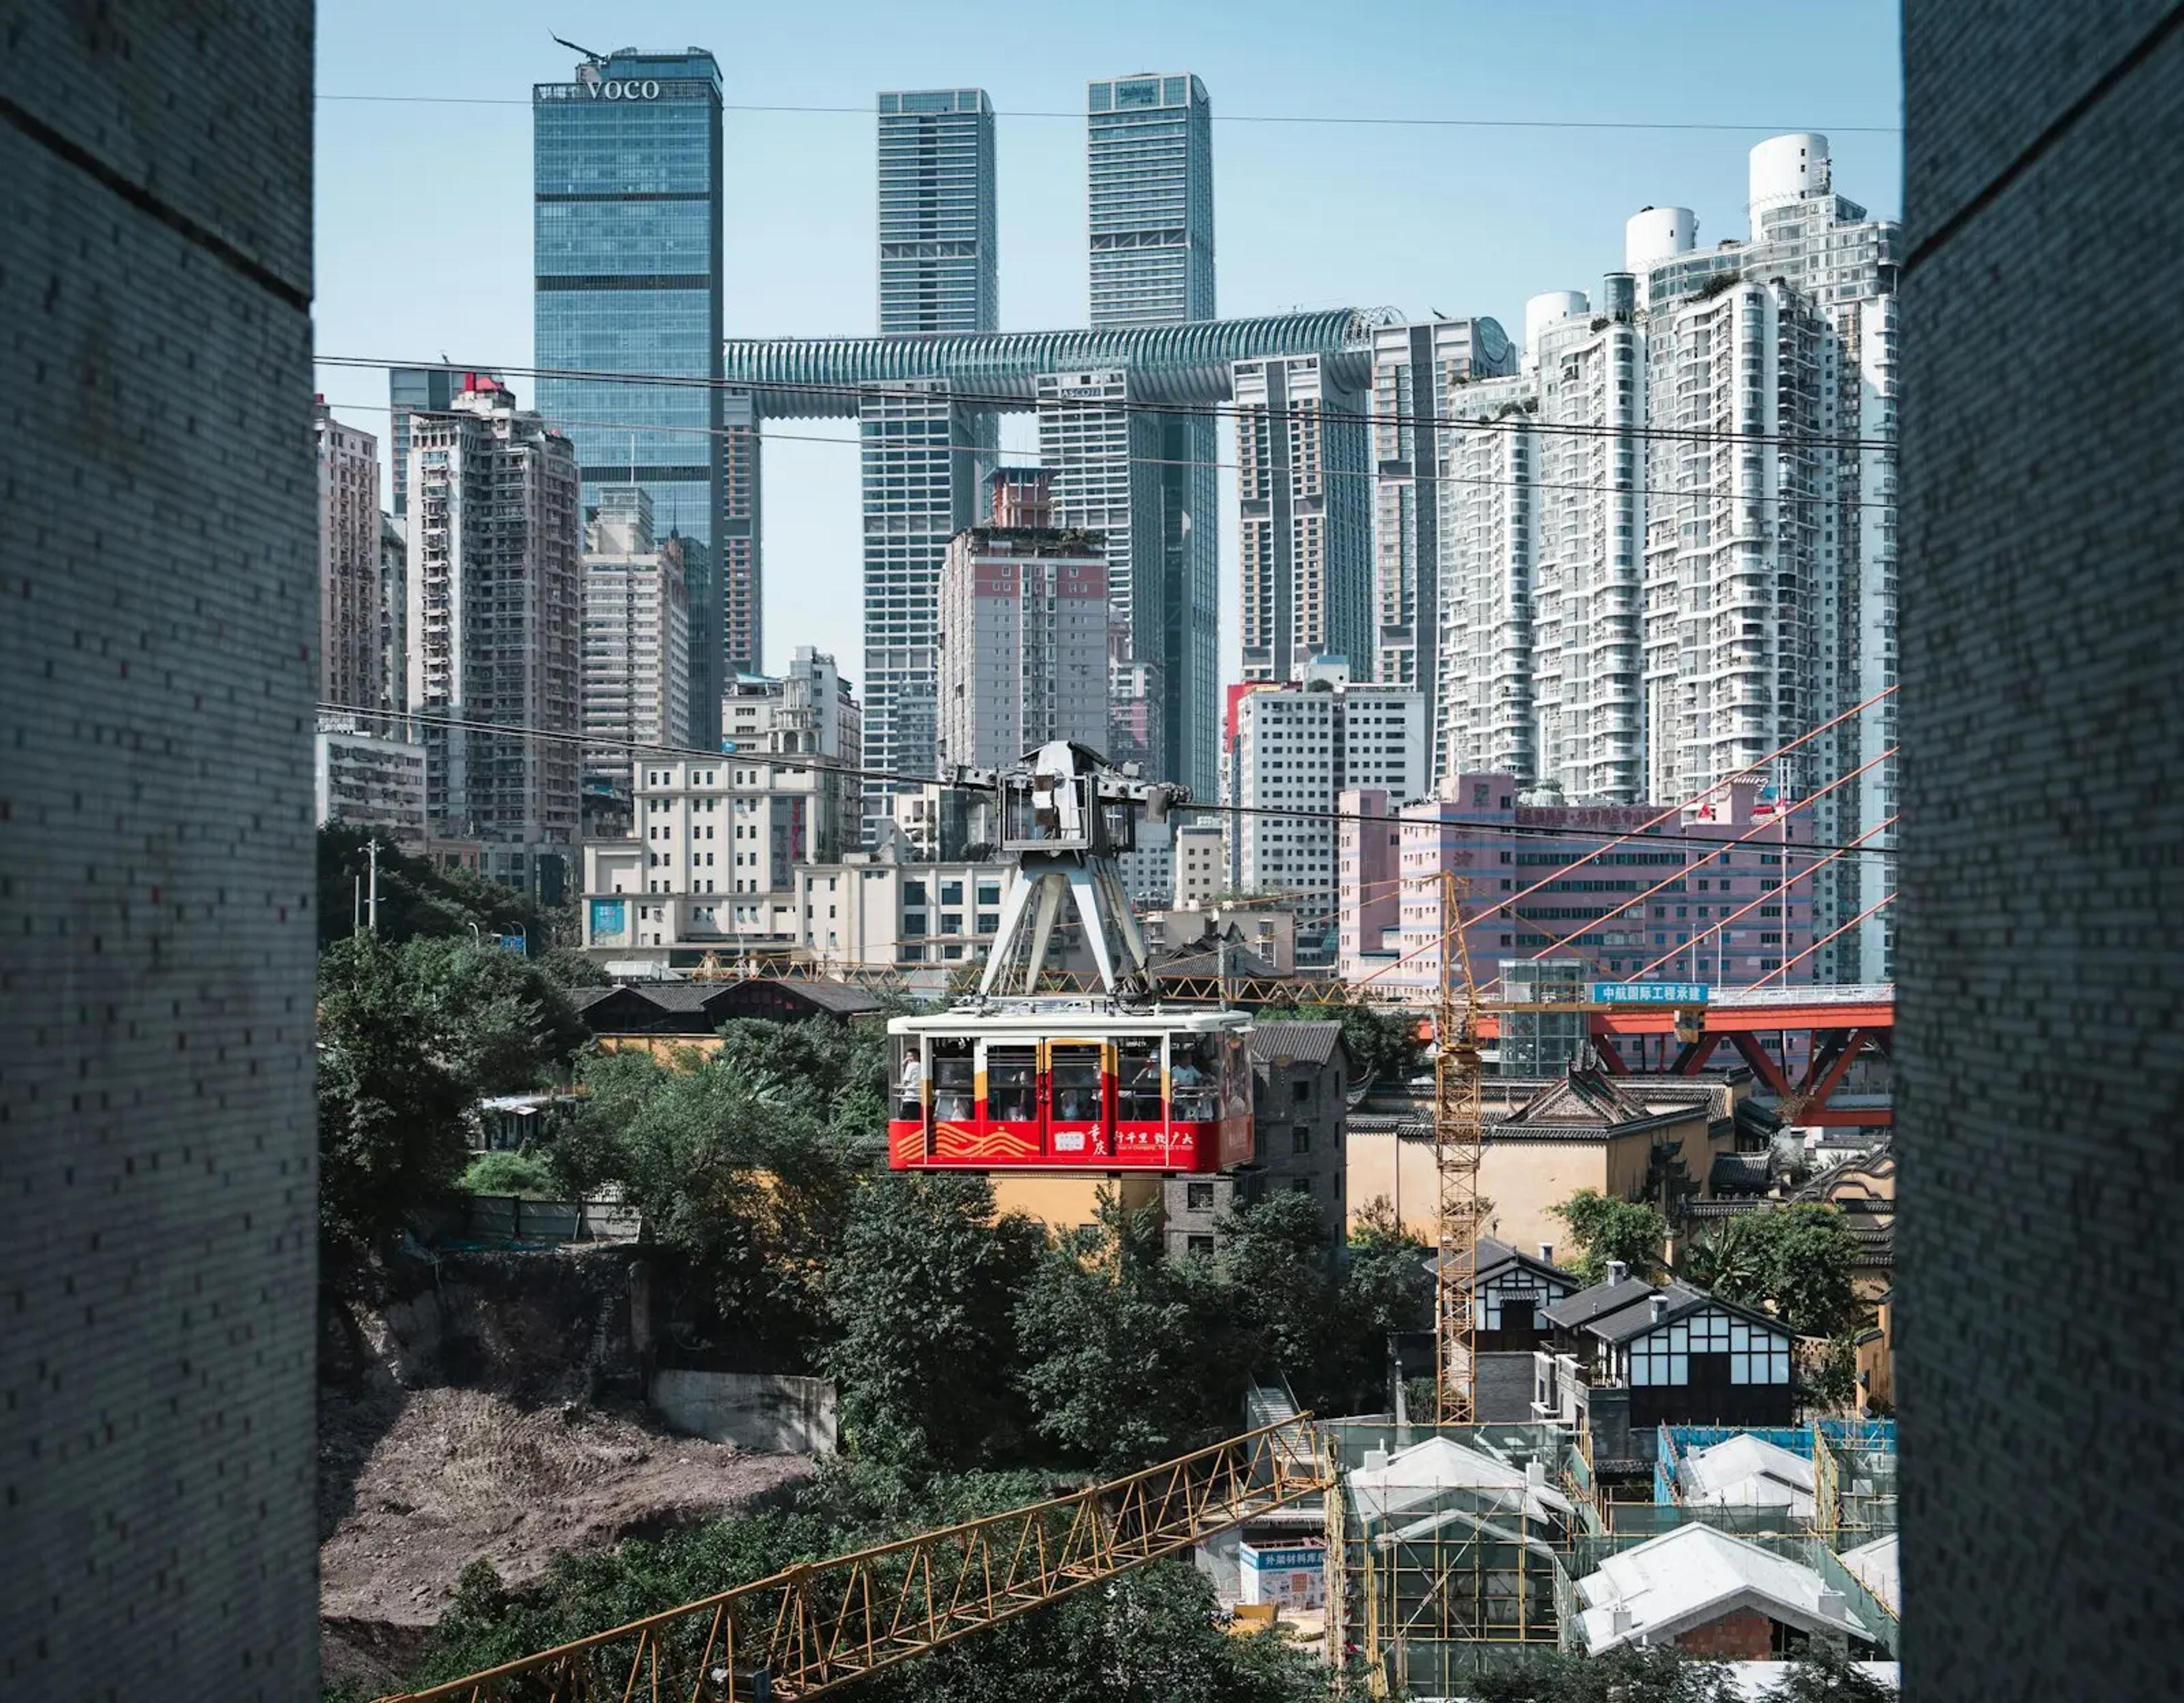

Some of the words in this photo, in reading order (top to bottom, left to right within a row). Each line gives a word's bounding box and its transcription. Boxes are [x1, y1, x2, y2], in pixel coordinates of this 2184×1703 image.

[1603, 986, 1701, 1001] 中航国际工程承建
[1087, 1124, 1108, 1155] 重庆
